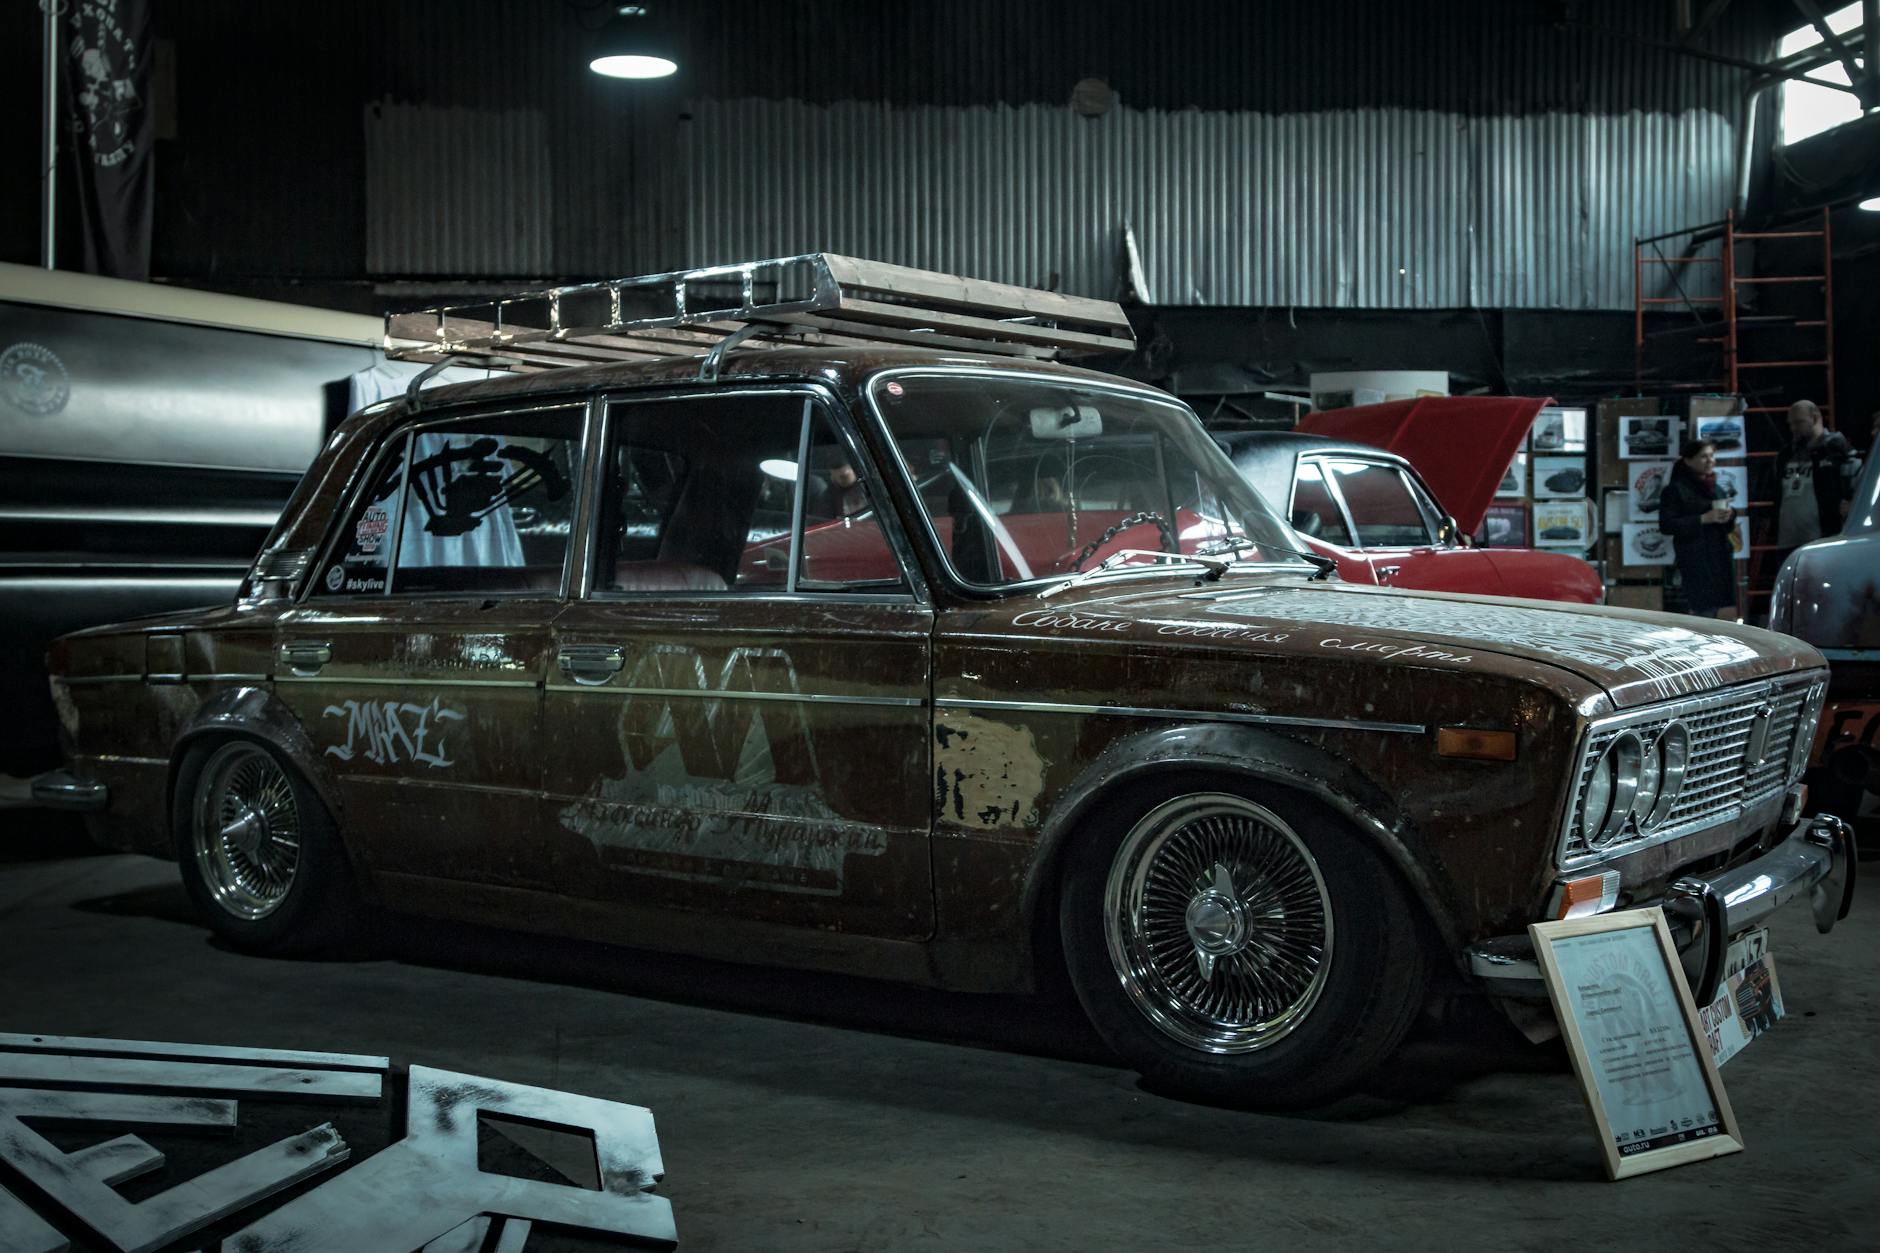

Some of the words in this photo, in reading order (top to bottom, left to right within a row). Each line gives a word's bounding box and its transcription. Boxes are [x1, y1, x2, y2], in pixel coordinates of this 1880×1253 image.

[362, 511, 387, 523] AUTO
[358, 534, 383, 544] SHOW
[1012, 608, 1133, 633] Собаке
[1319, 638, 1473, 664] смерть
[1623, 1141, 1651, 1153] auto.ru
